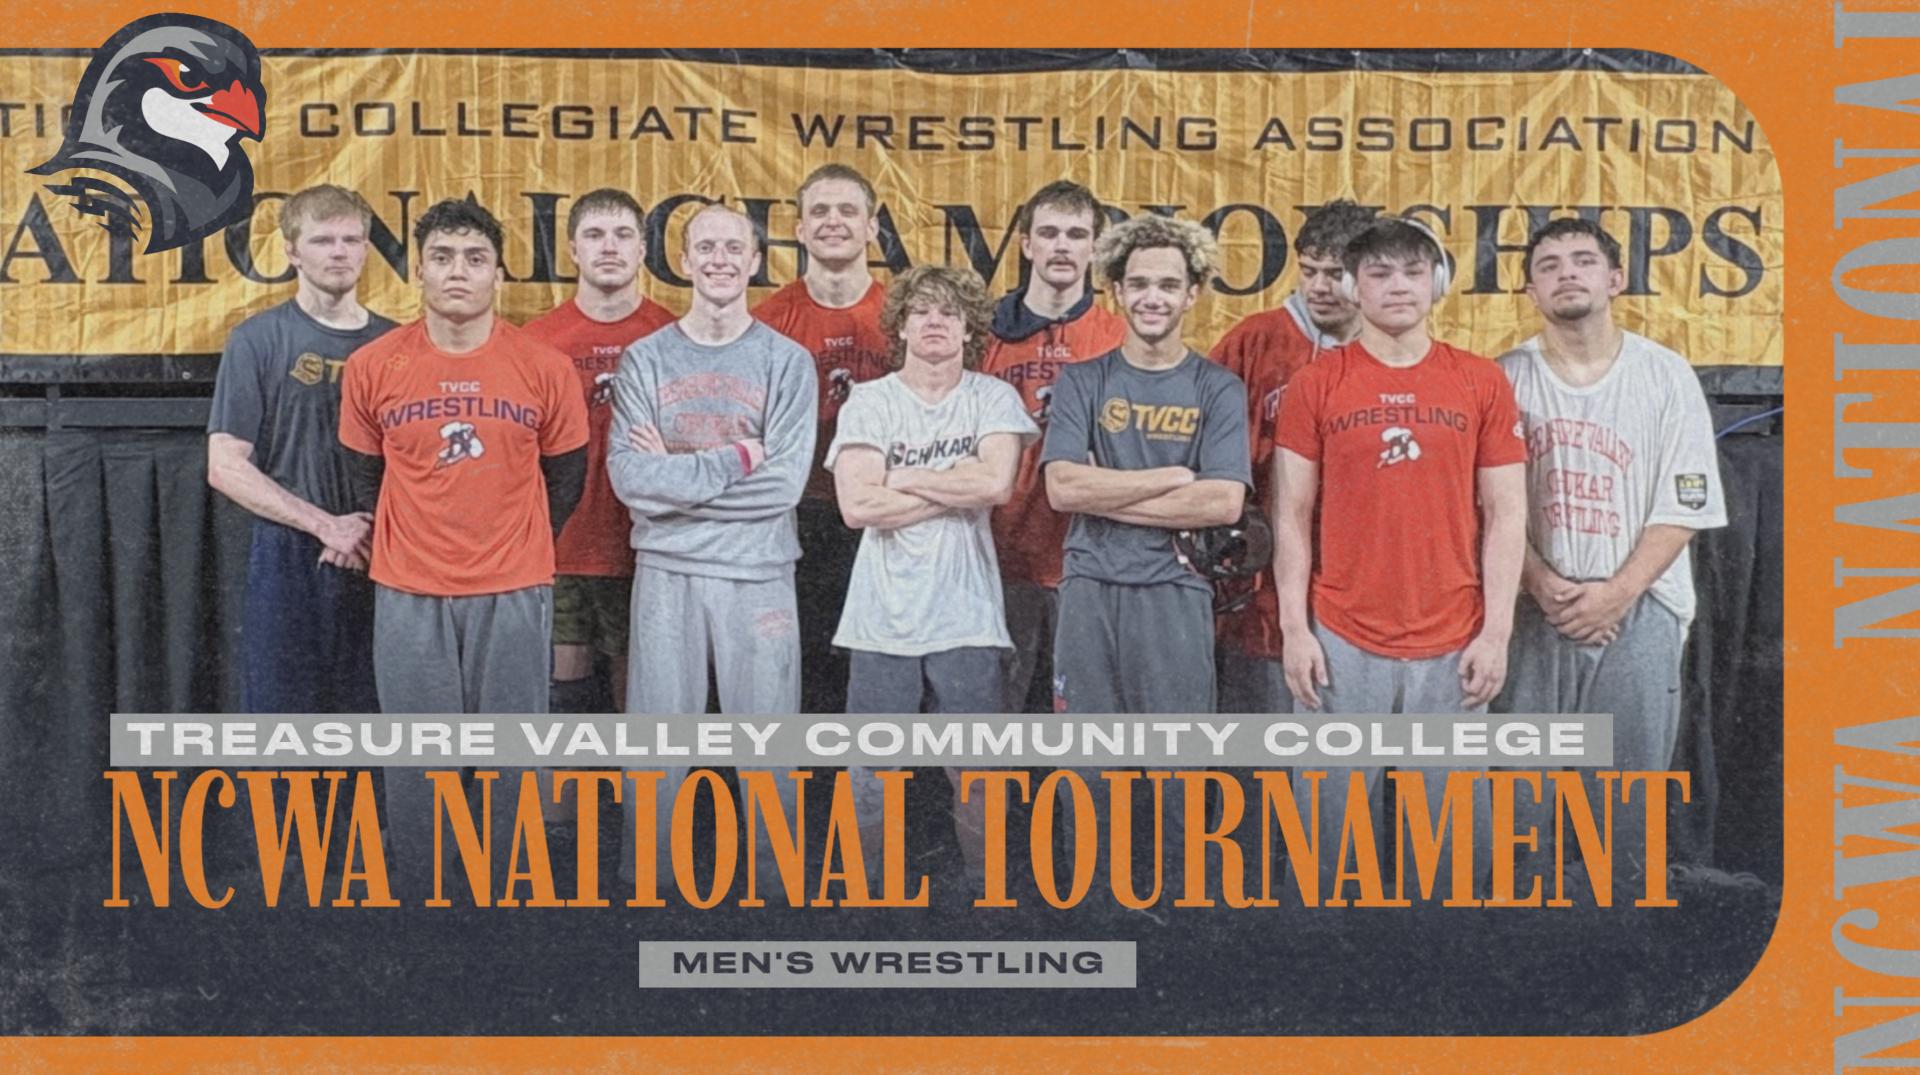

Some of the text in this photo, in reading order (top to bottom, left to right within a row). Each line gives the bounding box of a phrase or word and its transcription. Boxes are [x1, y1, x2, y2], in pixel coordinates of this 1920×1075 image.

[301, 102, 1755, 154] COLLEGIATE WRESTLING ASSOCIATION
[439, 381, 481, 393] TVCC
[1378, 392, 1416, 405] TVCC
[381, 396, 543, 431] WRESTLING
[1131, 403, 1200, 434] TVCC
[1328, 406, 1469, 433] WRESTLING
